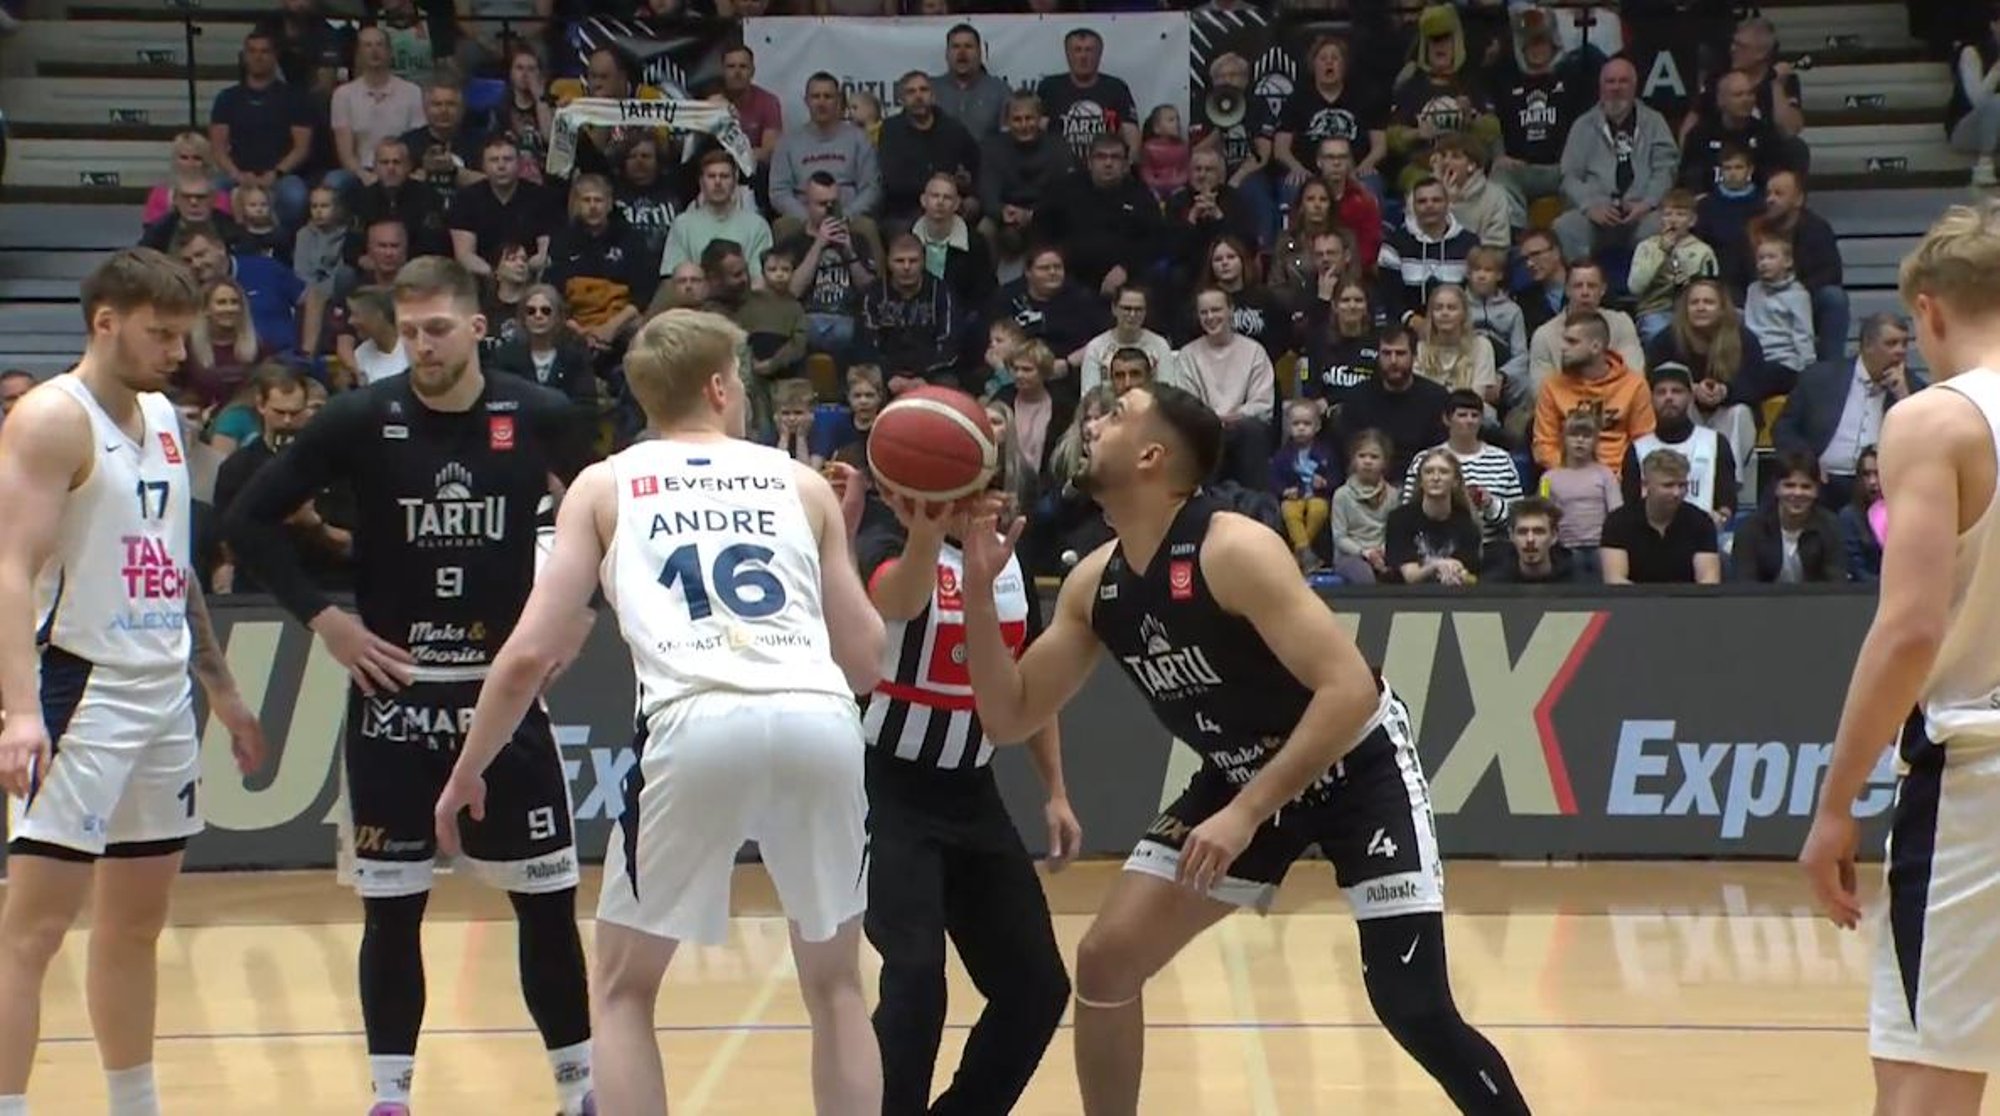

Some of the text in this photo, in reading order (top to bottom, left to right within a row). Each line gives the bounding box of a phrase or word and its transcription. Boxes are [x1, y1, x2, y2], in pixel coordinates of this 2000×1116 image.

[1642, 51, 1687, 97] A
[664, 476, 786, 491] EVENTUS
[137, 480, 169, 519] 17
[396, 496, 505, 542] TARTU
[649, 509, 776, 541] ANDRE
[121, 536, 173, 567] TAL
[122, 568, 187, 599] TECH
[436, 567, 464, 598] 9
[657, 543, 787, 621] 16
[108, 612, 184, 631] ALEXE
[408, 621, 465, 644] Maks
[1122, 646, 1223, 698] TARTU
[404, 706, 477, 734] MAR
[1195, 711, 1223, 734] 4
[1606, 720, 1899, 838] Expre
[178, 779, 197, 818] 1
[527, 806, 558, 841] 9
[1366, 827, 1398, 857] 4
